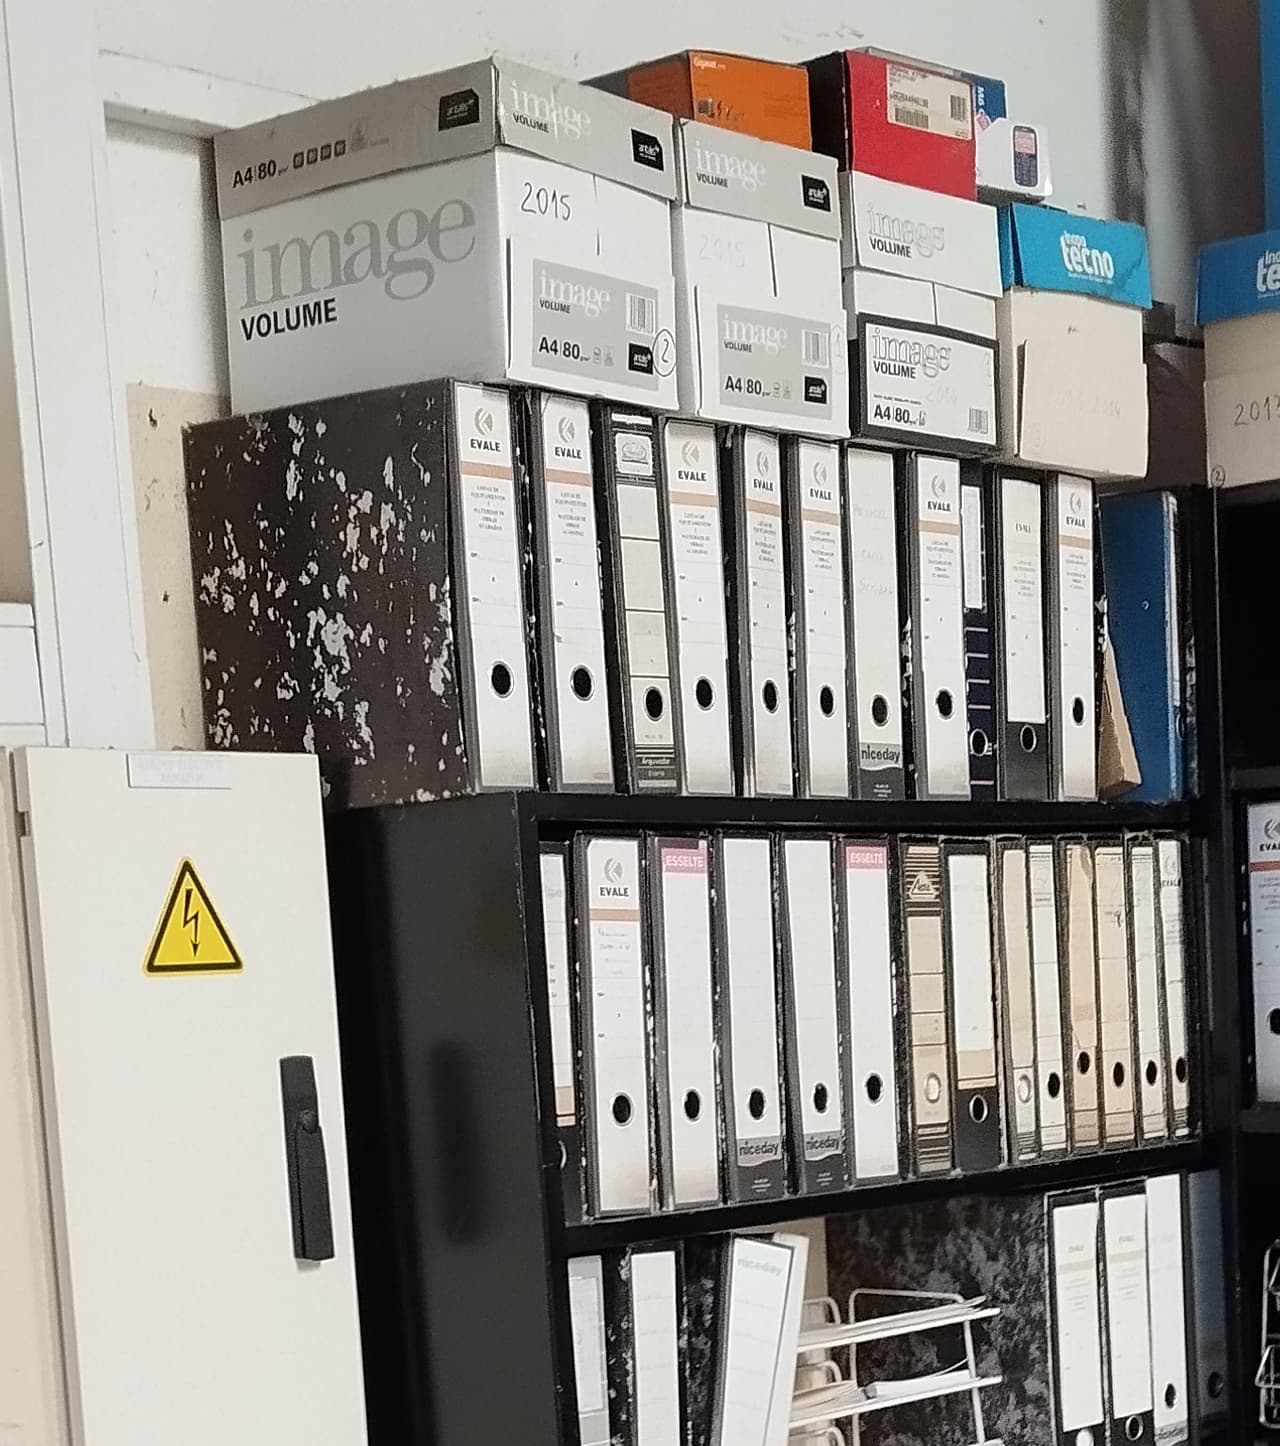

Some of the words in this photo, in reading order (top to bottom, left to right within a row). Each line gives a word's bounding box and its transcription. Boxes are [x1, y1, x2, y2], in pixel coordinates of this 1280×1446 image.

[510, 79, 592, 141] image
[512, 112, 550, 134] VOLUME
[232, 167, 254, 189] A4
[257, 158, 278, 181] 80
[695, 140, 767, 193] image
[696, 172, 729, 188] VOLUME
[520, 181, 574, 222] 2015
[867, 201, 946, 259] image
[238, 198, 477, 311] image
[869, 236, 913, 259] VOLUME
[1060, 235, 1115, 280] tecno
[539, 268, 611, 318] image
[539, 298, 572, 314] VOLUME
[240, 298, 339, 342] VOLUME
[723, 312, 788, 356] image
[538, 336, 559, 356] A4
[562, 343, 581, 360] 80
[723, 341, 753, 353] VOLUME
[872, 327, 952, 379] image
[873, 359, 917, 380] VOLUME
[724, 375, 743, 393] A4
[746, 378, 762, 395] 80
[873, 403, 891, 421] A4
[894, 406, 910, 425] 80
[470, 438, 502, 453] EVALE
[554, 446, 583, 460] EVALE
[677, 470, 708, 482] EVALE
[753, 478, 774, 492] EVALE
[809, 488, 832, 501] EVALE
[927, 501, 952, 513] EVALE
[1065, 516, 1086, 529] EVALE
[861, 743, 901, 764] niceday
[665, 854, 705, 869] ESSELTE
[849, 852, 885, 865] ESSELTE
[599, 886, 630, 898] EVALE
[738, 1140, 780, 1157] niceday
[805, 1134, 841, 1151] niceday
